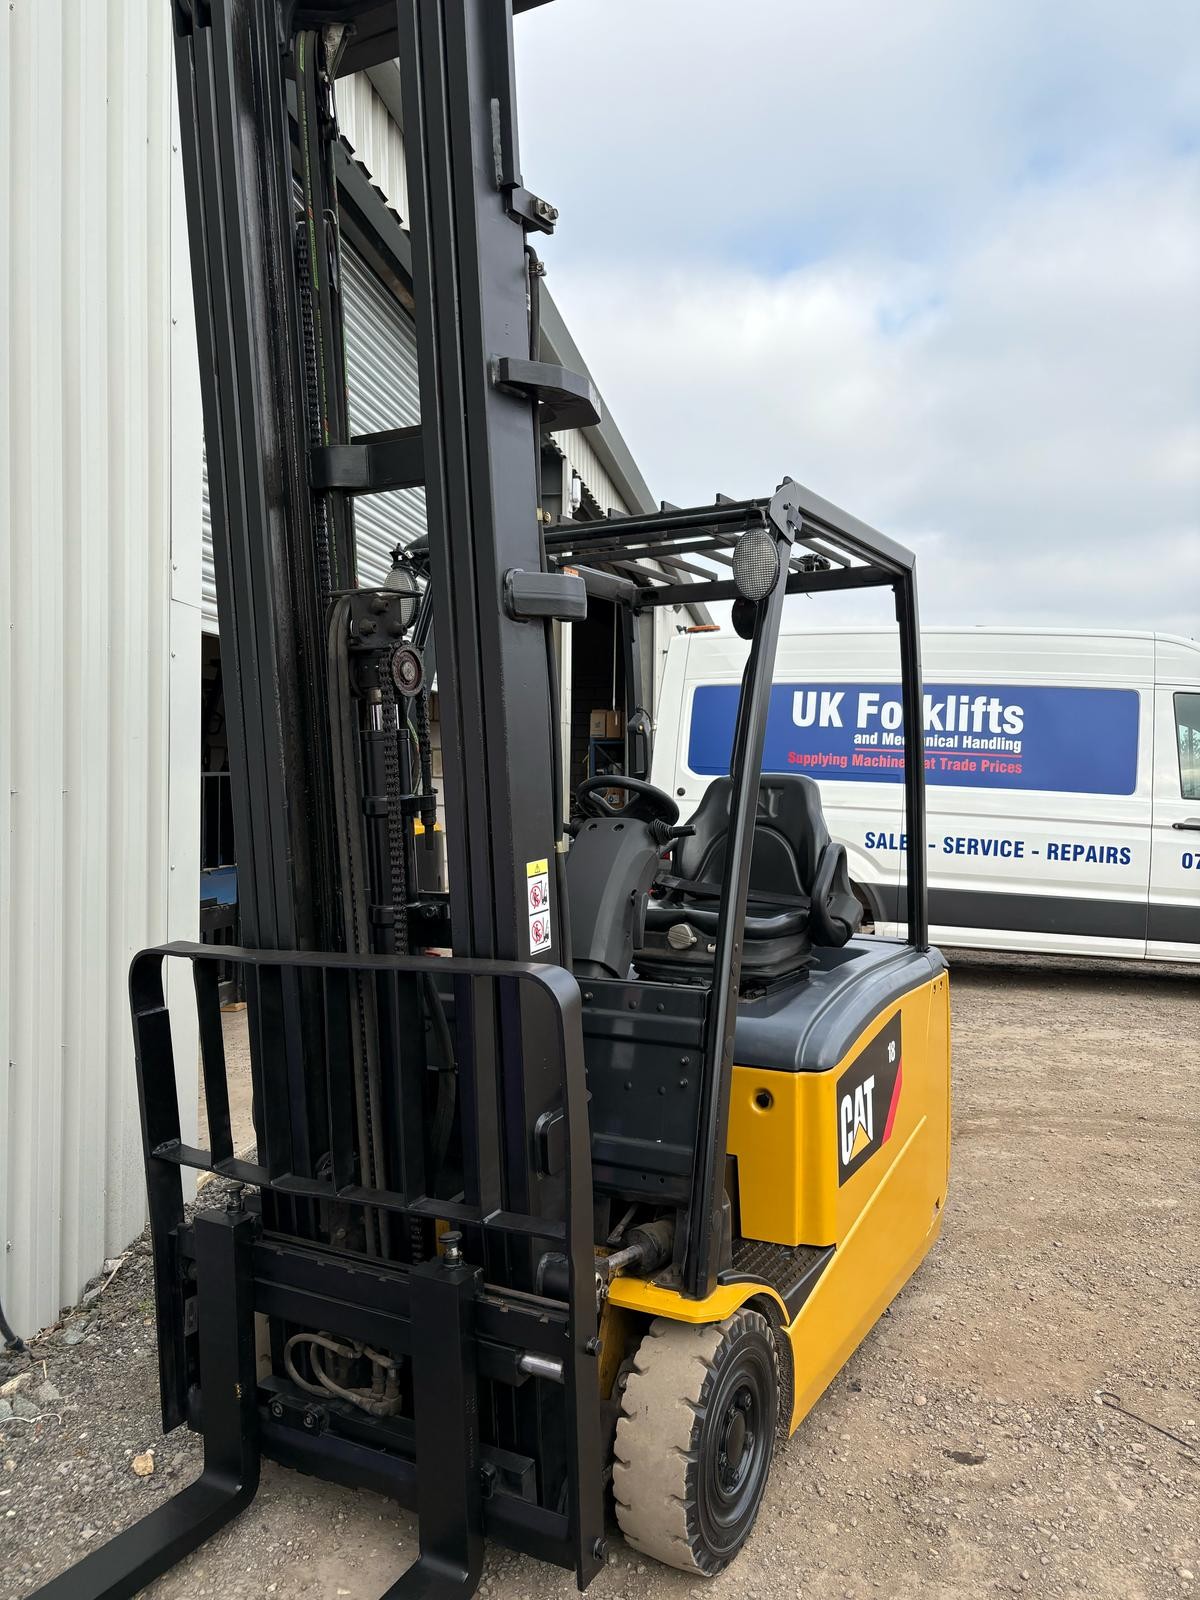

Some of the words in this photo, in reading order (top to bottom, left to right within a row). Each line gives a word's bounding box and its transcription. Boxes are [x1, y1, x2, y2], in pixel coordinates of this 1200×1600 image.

[792, 691, 846, 728] UK
[857, 692, 1024, 735] Foklifts
[854, 732, 878, 745] and
[962, 736, 1022, 753] Handling
[787, 751, 848, 769] Supplying
[924, 758, 935, 769] at
[940, 758, 976, 772] Trade
[981, 759, 1022, 774] Prices
[865, 832, 908, 851] SALE
[943, 836, 1024, 859] SERVICE
[1047, 842, 1131, 866] REPAIRS
[840, 1074, 875, 1166] CAT
